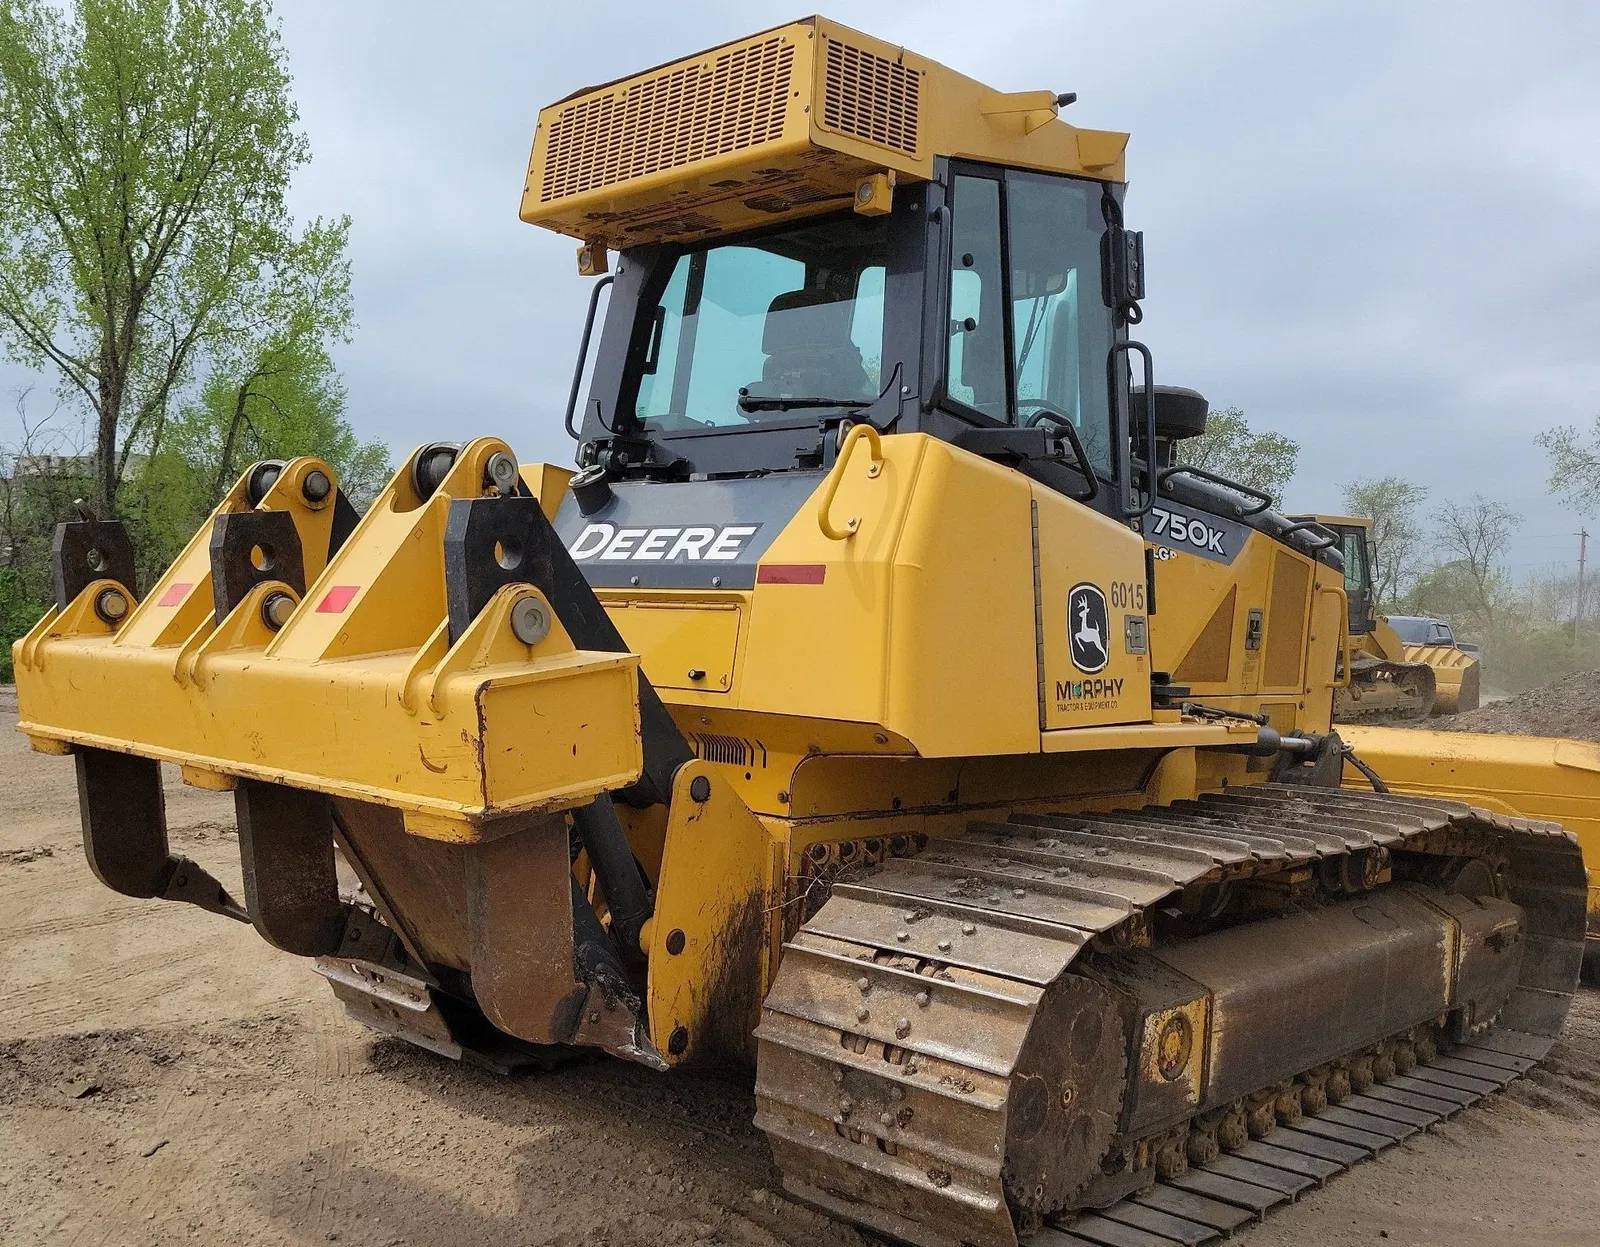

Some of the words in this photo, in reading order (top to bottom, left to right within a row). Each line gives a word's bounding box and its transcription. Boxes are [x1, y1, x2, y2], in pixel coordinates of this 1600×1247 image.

[568, 523, 758, 560] DEERE
[1151, 507, 1226, 556] 750K
[1111, 581, 1143, 609] 6015
[1056, 678, 1123, 701] MURPHY
[1057, 702, 1079, 712] TRACTOR
[1085, 701, 1110, 711] EQUIPMENT
